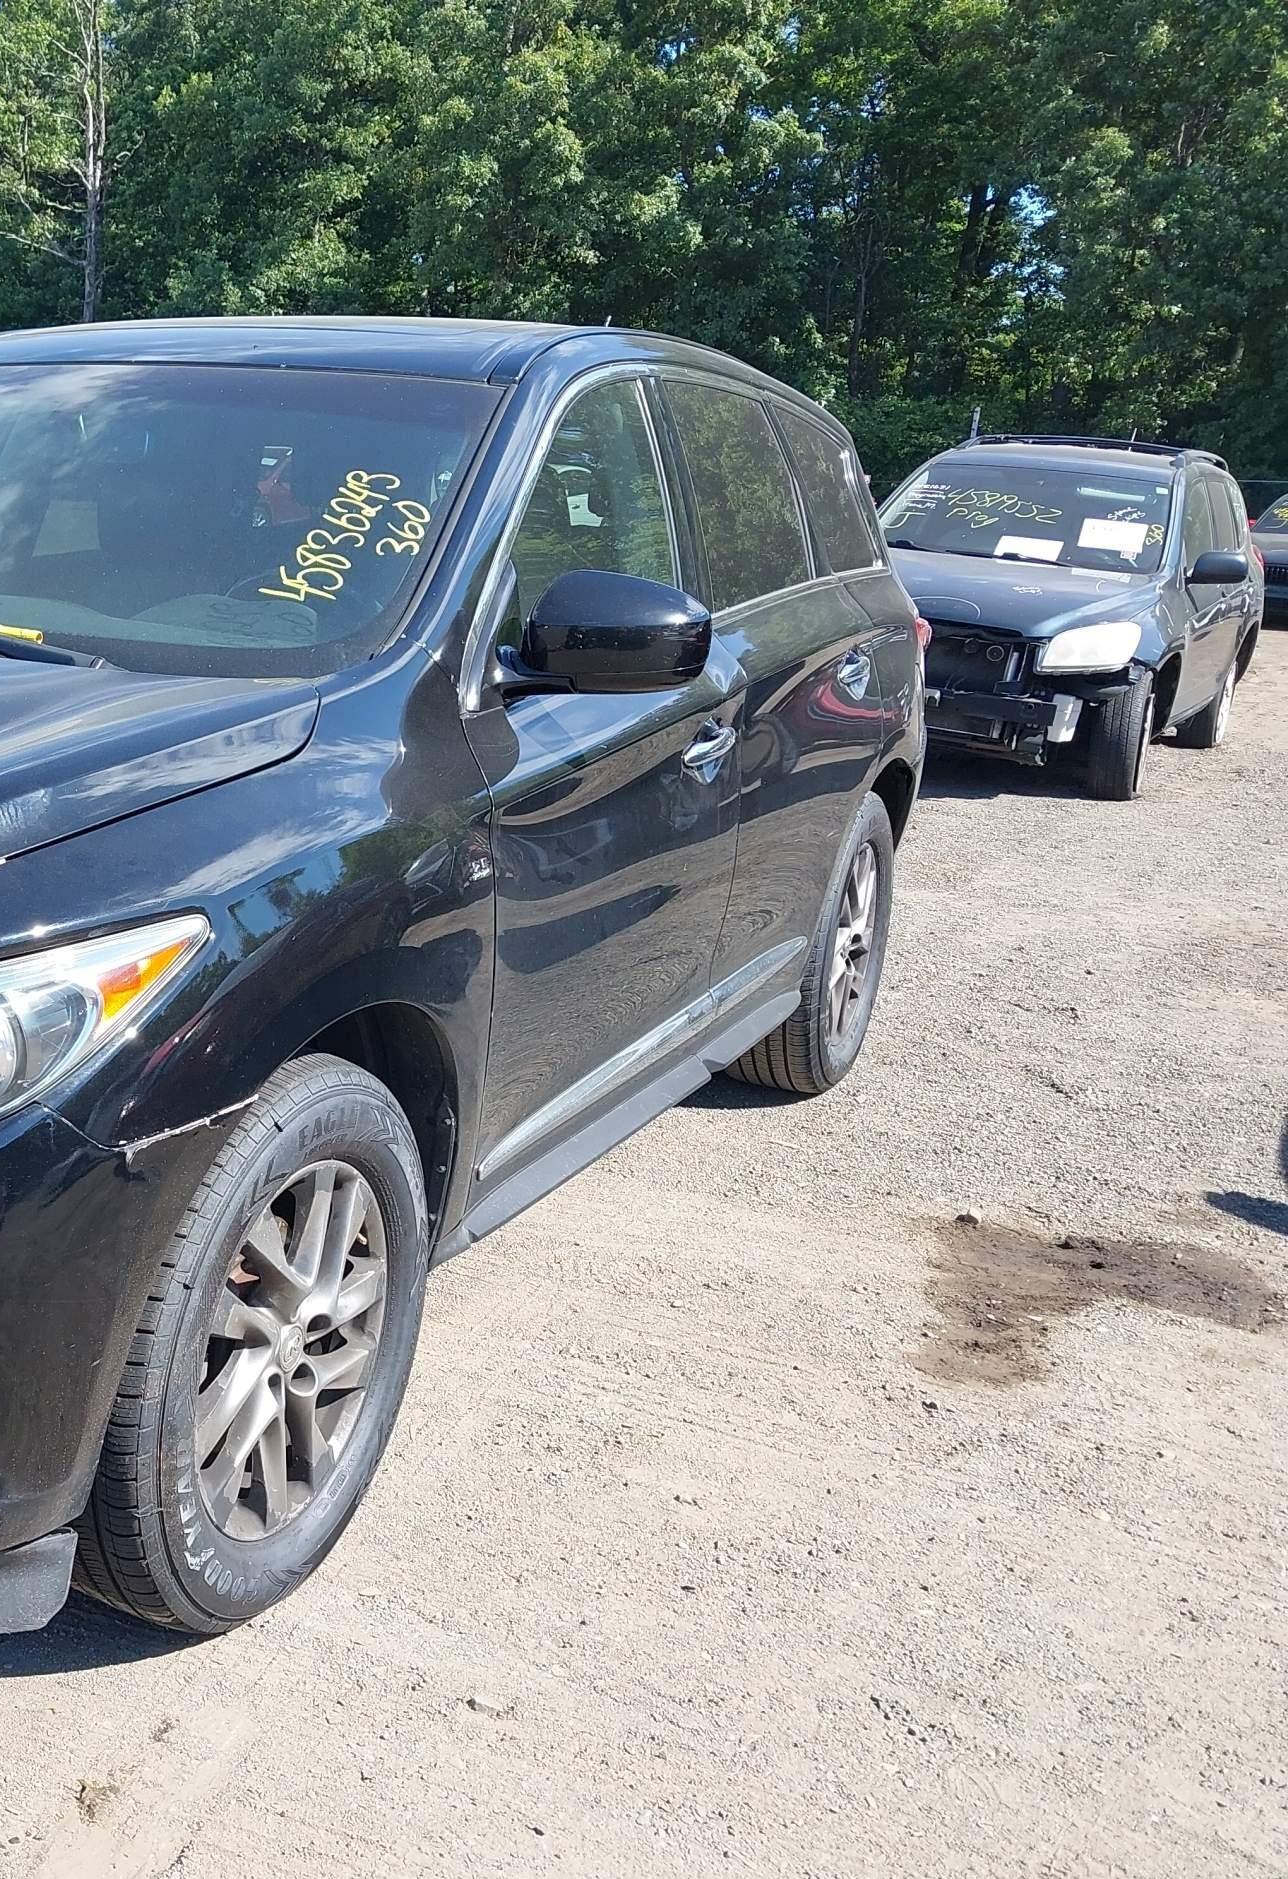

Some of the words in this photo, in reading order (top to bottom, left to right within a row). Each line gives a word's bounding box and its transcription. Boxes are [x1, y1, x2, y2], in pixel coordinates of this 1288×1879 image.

[258, 470, 401, 601] 45836243
[375, 500, 431, 556] 360
[175, 1438, 259, 1602] GOODYEAR
